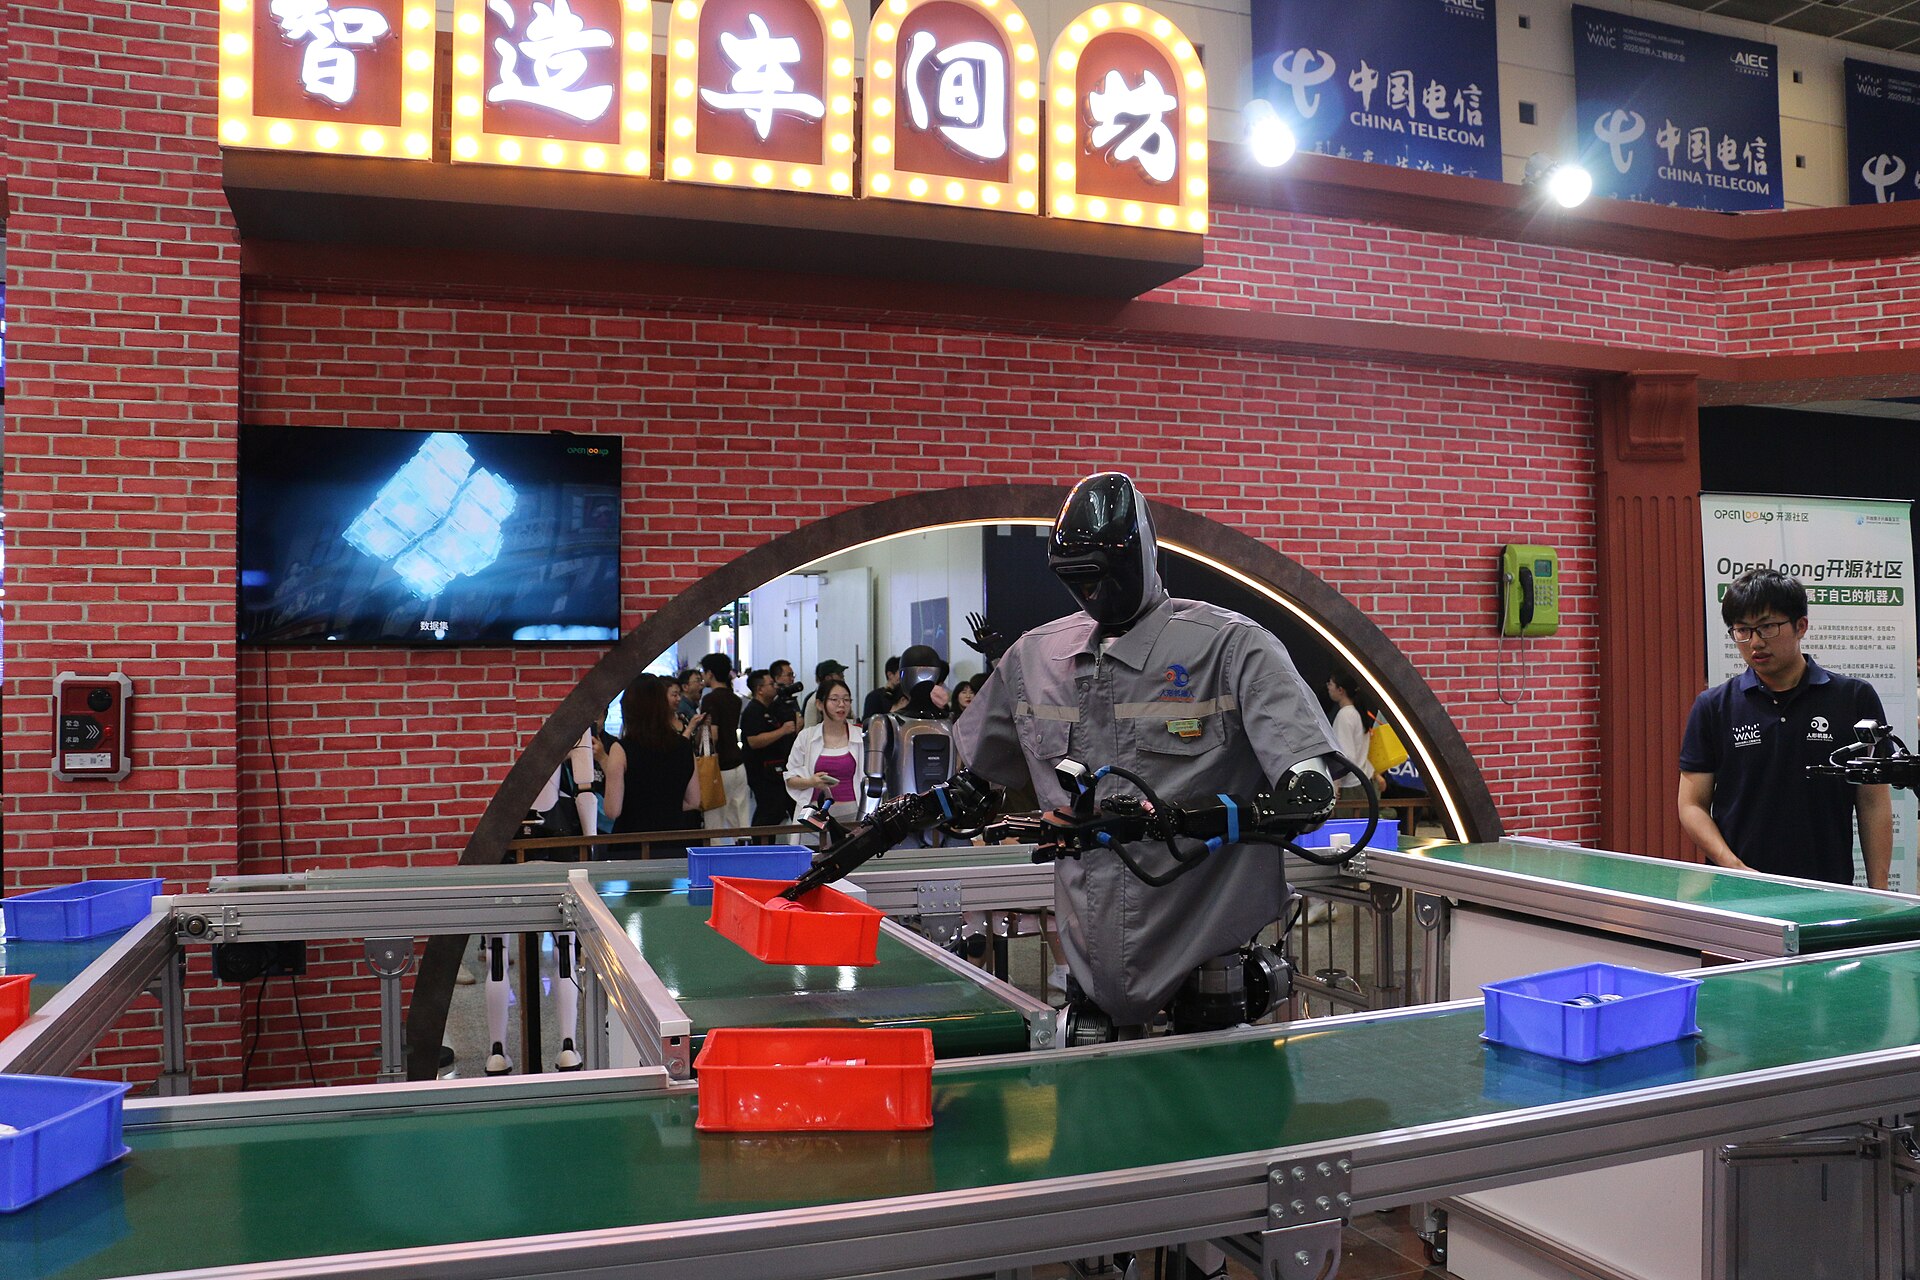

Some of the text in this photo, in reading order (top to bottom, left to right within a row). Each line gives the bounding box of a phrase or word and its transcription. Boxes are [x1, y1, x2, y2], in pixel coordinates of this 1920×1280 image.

[1587, 32, 1616, 49] WAIC
[1733, 52, 1769, 69] AIEC
[1348, 59, 1483, 127] 中国电信
[1857, 83, 1882, 98] WAIC
[1350, 111, 1485, 148] CHINA TELECOM
[1656, 118, 1768, 176] 中国电信
[1658, 166, 1770, 195] CHINA TELECOM
[1776, 512, 1809, 523] 开源社区
[1805, 588, 1901, 604] 属于自己的机器人
[419, 620, 449, 631] 数据集
[1733, 730, 1761, 741] WAIC
